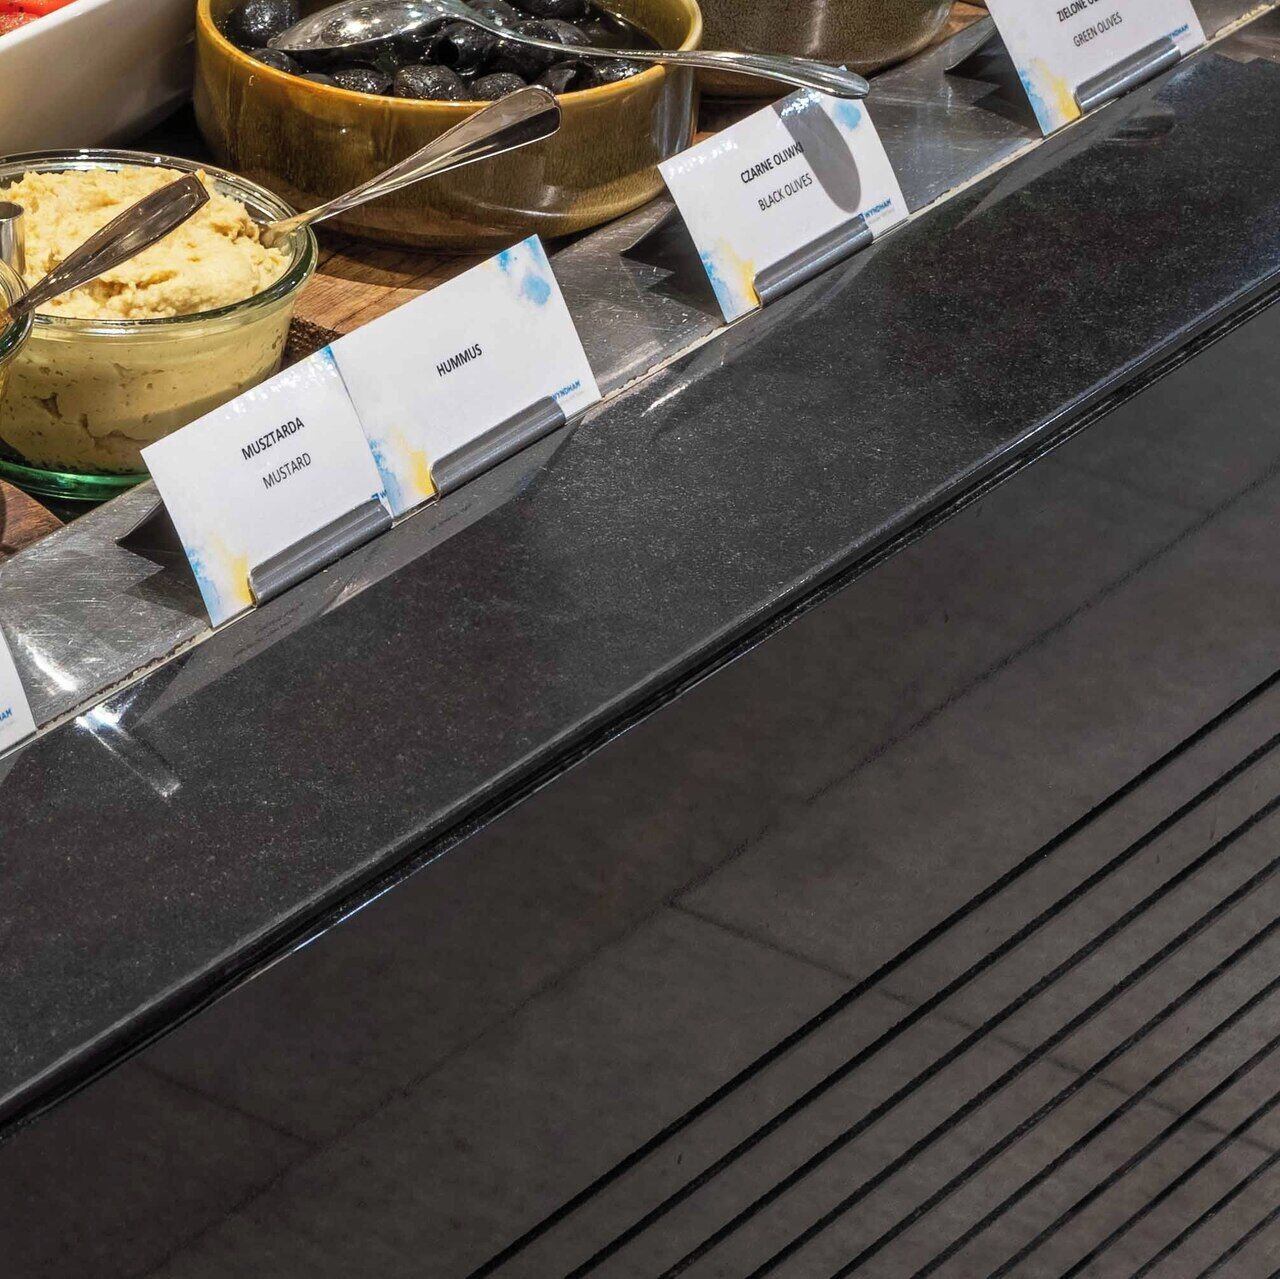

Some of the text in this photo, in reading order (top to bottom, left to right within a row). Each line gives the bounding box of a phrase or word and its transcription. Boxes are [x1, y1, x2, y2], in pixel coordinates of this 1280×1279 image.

[1073, 11, 1123, 48] GREEN OLIVES
[740, 141, 805, 184] CZARNE OLIWKI
[757, 172, 813, 211] BLACK OLIVES
[436, 343, 483, 377] HUMMUS
[241, 416, 305, 460] MUSZTARDA
[262, 452, 312, 489] MUSTARD
